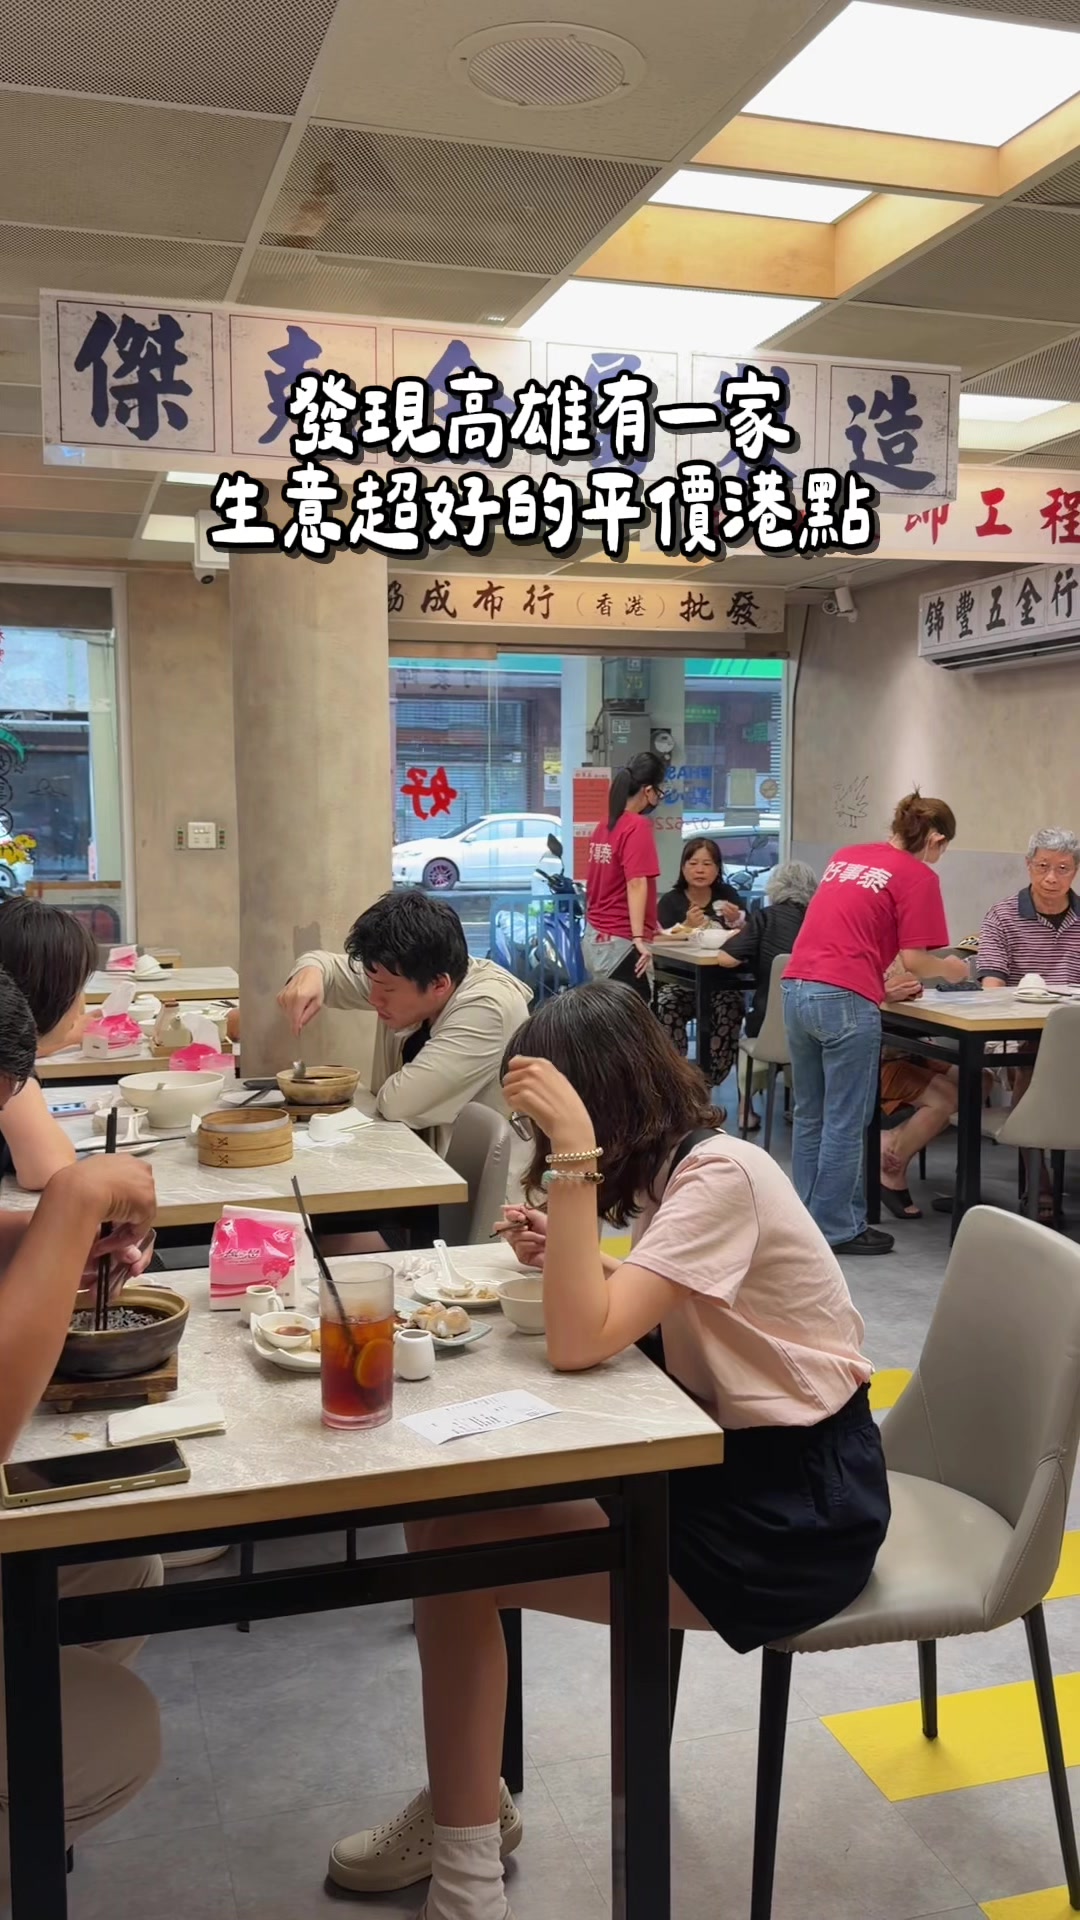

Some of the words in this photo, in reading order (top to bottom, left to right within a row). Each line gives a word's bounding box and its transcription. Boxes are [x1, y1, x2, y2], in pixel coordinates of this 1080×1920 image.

[924, 567, 1079, 644] 錦豐五金行
[821, 861, 893, 894] 好事泰
